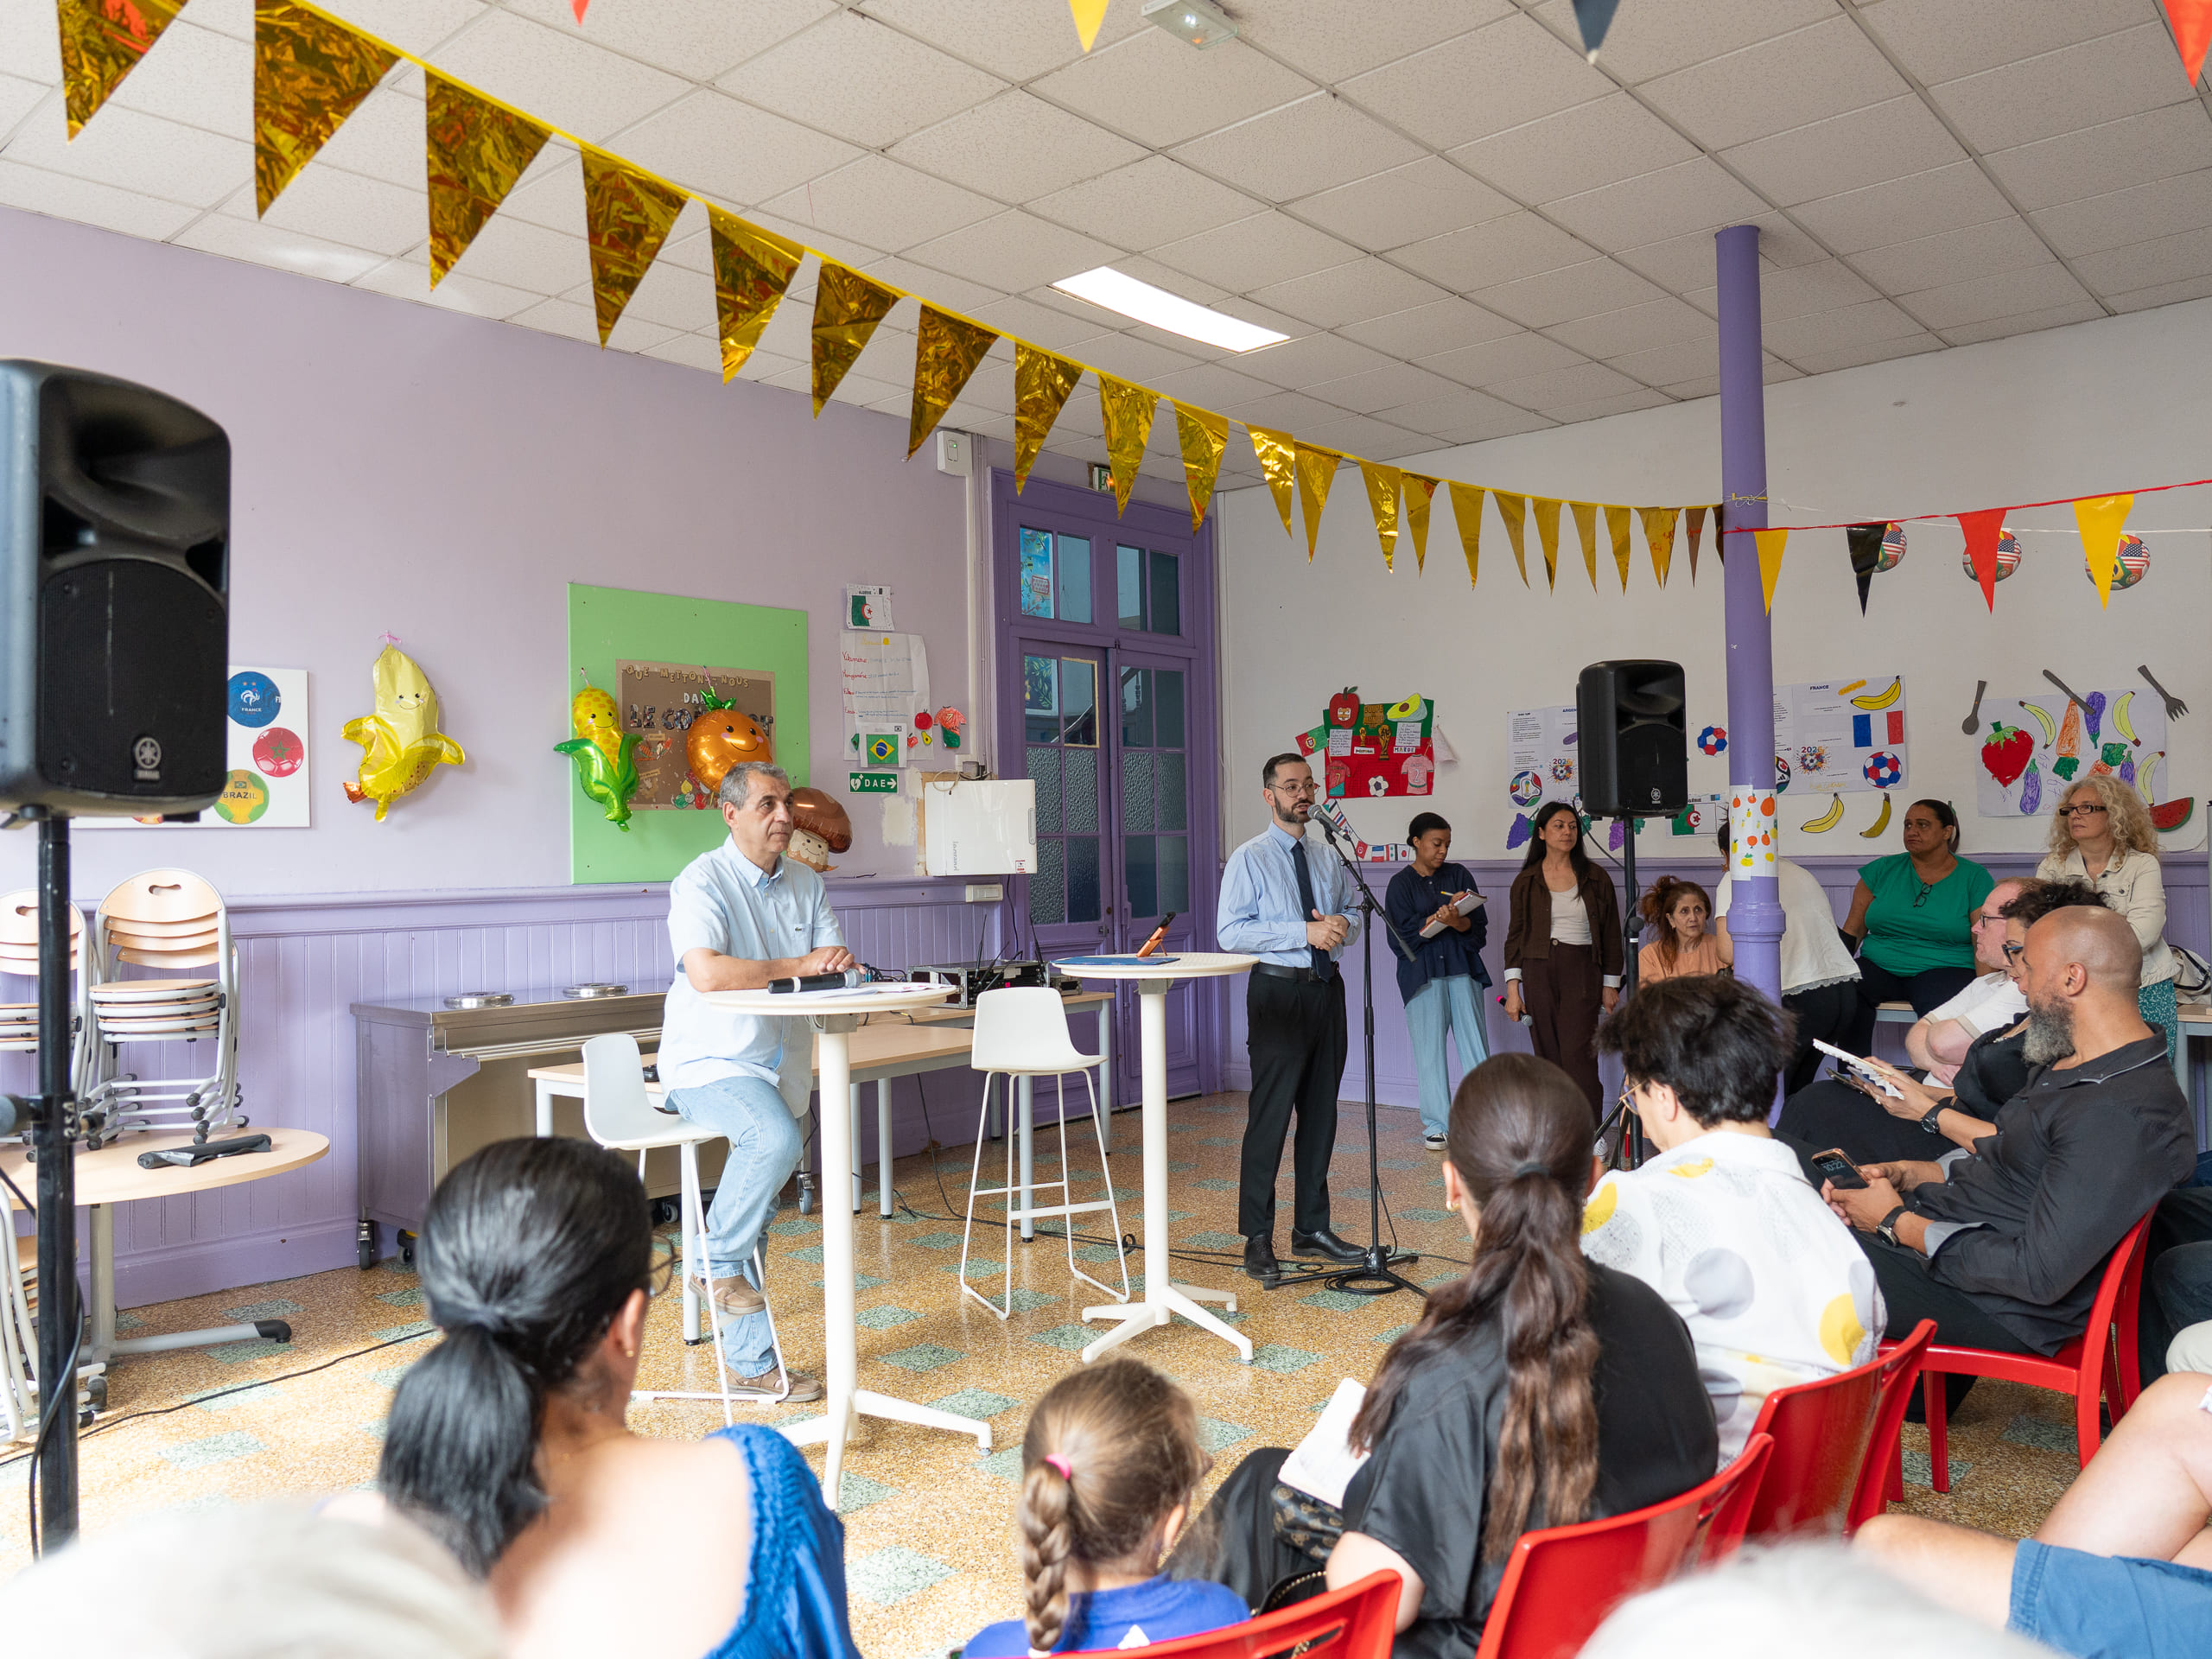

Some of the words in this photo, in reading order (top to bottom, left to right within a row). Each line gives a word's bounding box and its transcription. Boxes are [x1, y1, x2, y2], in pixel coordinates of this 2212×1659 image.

[626, 664, 650, 680] QUE
[630, 704, 656, 729] LE
[945, 713, 953, 722] 7
[864, 779, 887, 788] DAE
[223, 791, 257, 799] BRAZIL
